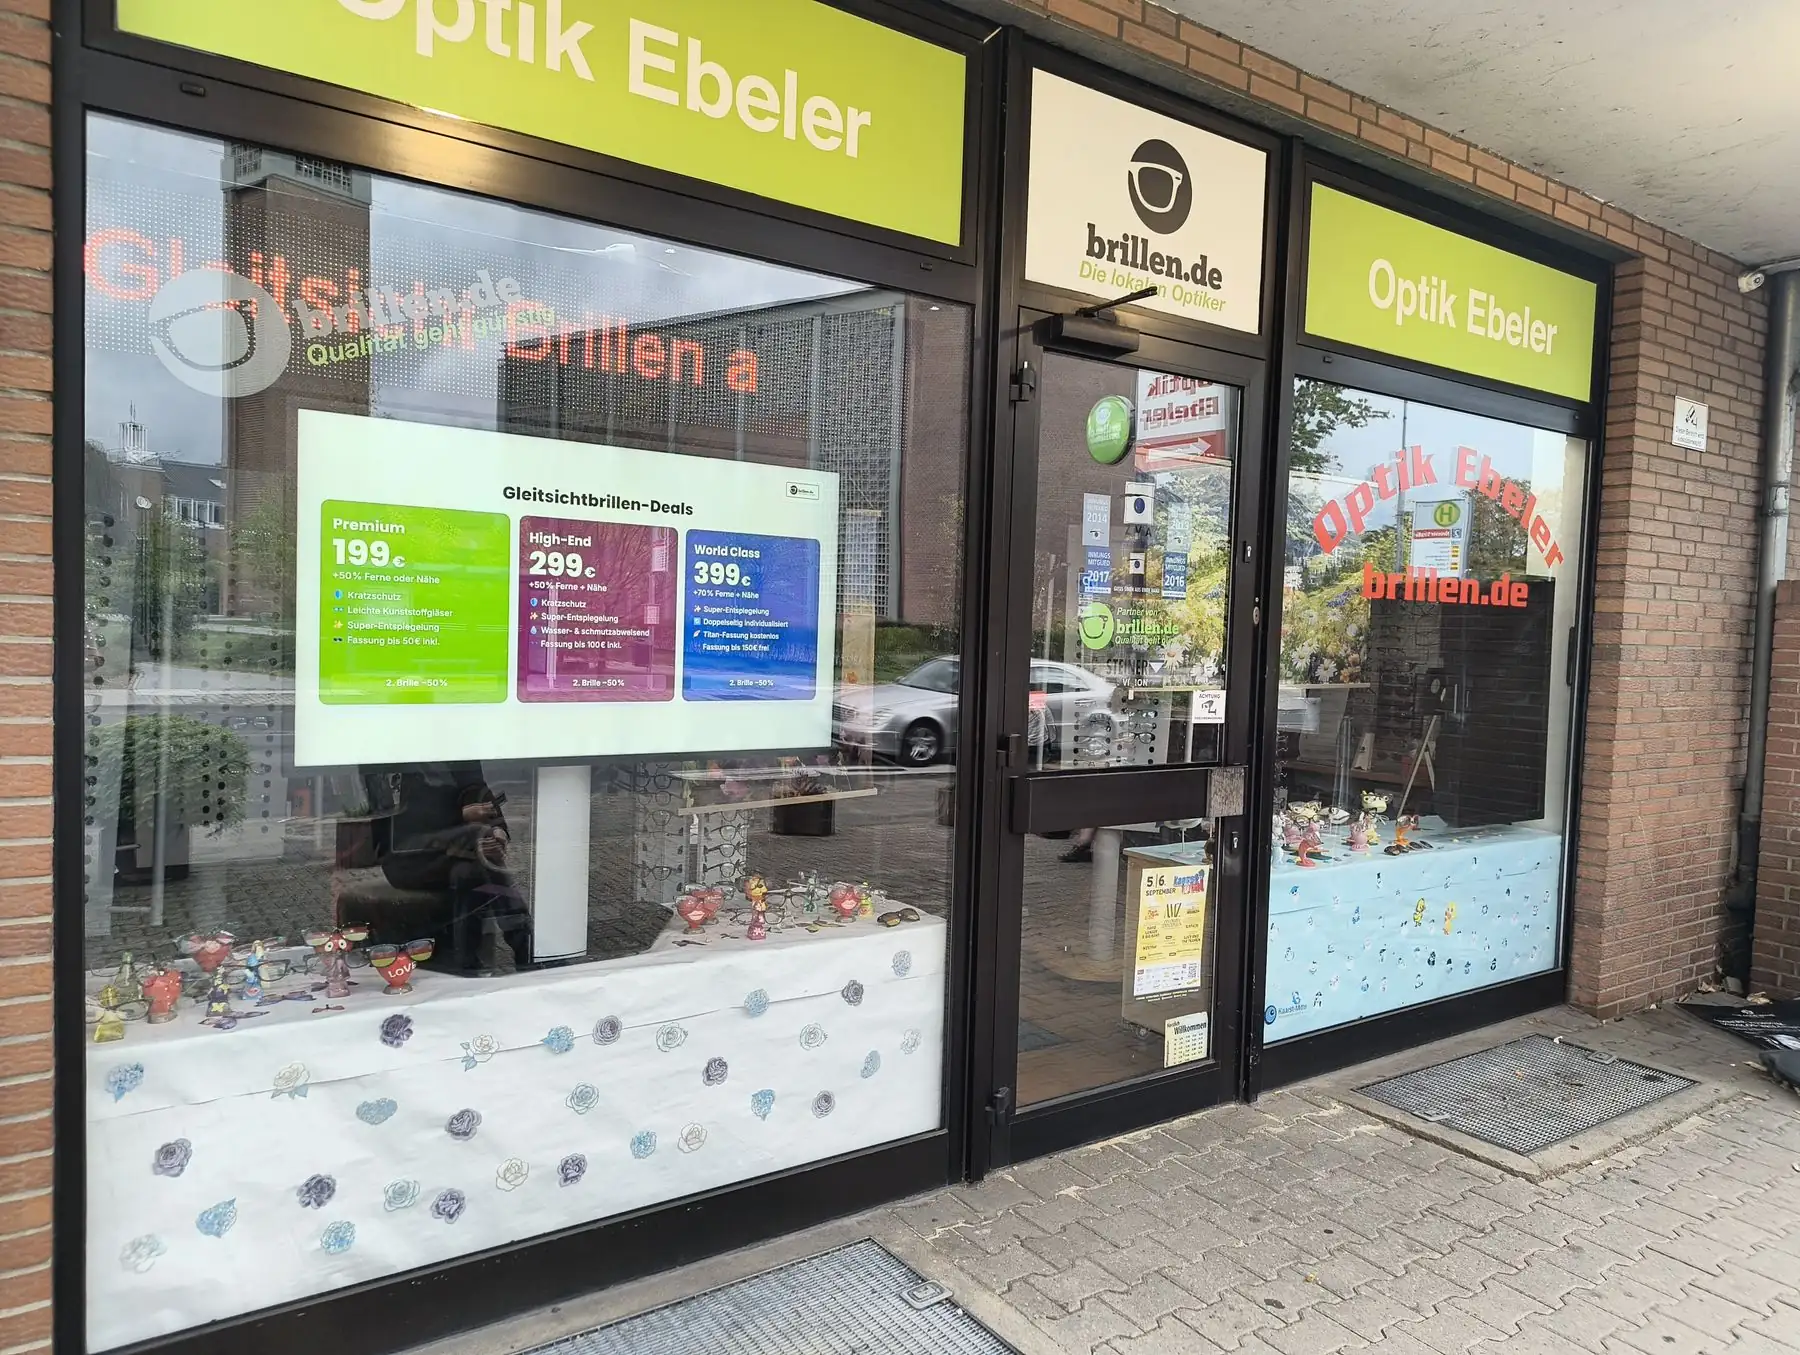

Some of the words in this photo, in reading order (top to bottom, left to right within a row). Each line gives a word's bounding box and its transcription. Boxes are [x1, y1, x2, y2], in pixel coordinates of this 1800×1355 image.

[628, 18, 871, 158] Ebeler
[1086, 222, 1222, 290] brillen.de
[1079, 260, 1107, 283] Die
[1172, 284, 1226, 312] Optiker
[292, 269, 526, 340] brillen.de
[1369, 258, 1457, 328] Optik
[1467, 287, 1557, 355] Ebeler
[307, 328, 407, 367] Qualität
[506, 299, 703, 387] Brillen
[727, 349, 758, 394] a
[502, 486, 694, 516] Gleitsichtbrillen-Deals
[1312, 444, 1438, 555] Optik
[1455, 446, 1563, 568] Ebeler
[1087, 512, 1107, 523] 2014
[332, 518, 405, 534] Premium
[529, 532, 592, 547] High-End
[694, 544, 728, 557] World
[730, 547, 760, 558] Class
[364, 572, 391, 583] Ferne
[394, 573, 415, 583] oder
[416, 574, 440, 584] Nähe
[1088, 570, 1110, 583] 2017
[1164, 575, 1185, 587] 2016
[555, 582, 578, 590] Ferne
[587, 583, 607, 592] Nähe
[1362, 562, 1528, 608] brillen.de
[347, 591, 401, 601] Kratzschutz
[715, 590, 734, 598] Ferne
[742, 591, 759, 599] Nähe
[541, 599, 586, 608] Kratzschutz
[347, 607, 380, 615] Leichte
[382, 607, 453, 618] Kunststoffgläser
[703, 605, 770, 617] Super-Entspiegelung
[1116, 607, 1144, 616] Partner
[541, 613, 618, 624] Super-Entspiegelung
[703, 618, 743, 628] Doppelseitig
[744, 619, 789, 628] individualisiert
[347, 621, 440, 633] Super-Entspiegelung
[540, 627, 572, 635] Wasser-
[581, 627, 650, 637] schmutzabweisend
[1116, 618, 1179, 635] brillen.de
[347, 636, 385, 646] Fassung
[387, 637, 400, 645] bis
[402, 637, 420, 646] 50€
[422, 638, 440, 646] inkl.
[703, 630, 748, 640] Titan-Fassung
[750, 632, 779, 640] kostenlos
[540, 640, 572, 650] Fassung
[607, 641, 622, 649] inkl.
[702, 643, 729, 653] Fassung
[759, 644, 769, 652] frei
[1106, 658, 1149, 676] STEINER
[385, 679, 395, 687] 2.
[396, 679, 419, 687] Brille
[572, 679, 580, 687] 2.
[582, 679, 601, 687] Brille
[1122, 678, 1148, 687] VIION
[1145, 887, 1177, 897] SEPTEMBER
[387, 961, 417, 978] LOVE
[1173, 1021, 1207, 1035] Willkommen
